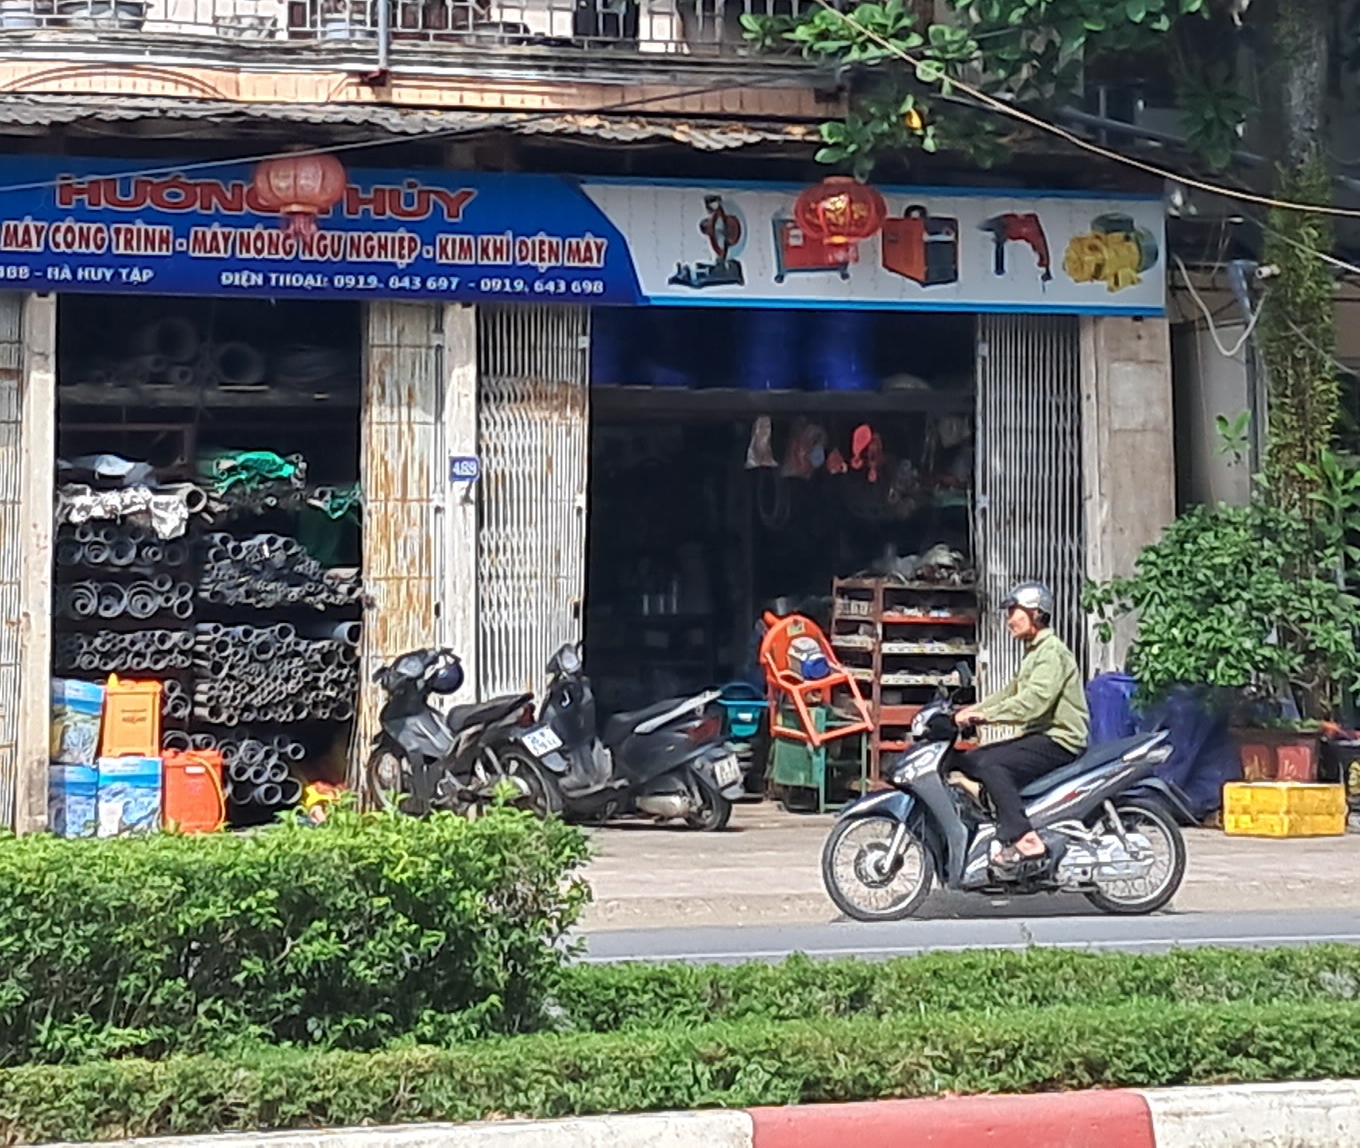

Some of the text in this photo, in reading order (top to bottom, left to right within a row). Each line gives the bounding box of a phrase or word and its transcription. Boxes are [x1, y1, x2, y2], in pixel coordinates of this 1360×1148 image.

[436, 233, 476, 265] KIM
[477, 230, 514, 266] KHÍ
[516, 232, 563, 273] ĐIỆN
[563, 230, 608, 269] MÁY
[47, 263, 73, 282] HÀ
[77, 268, 115, 282] HUY
